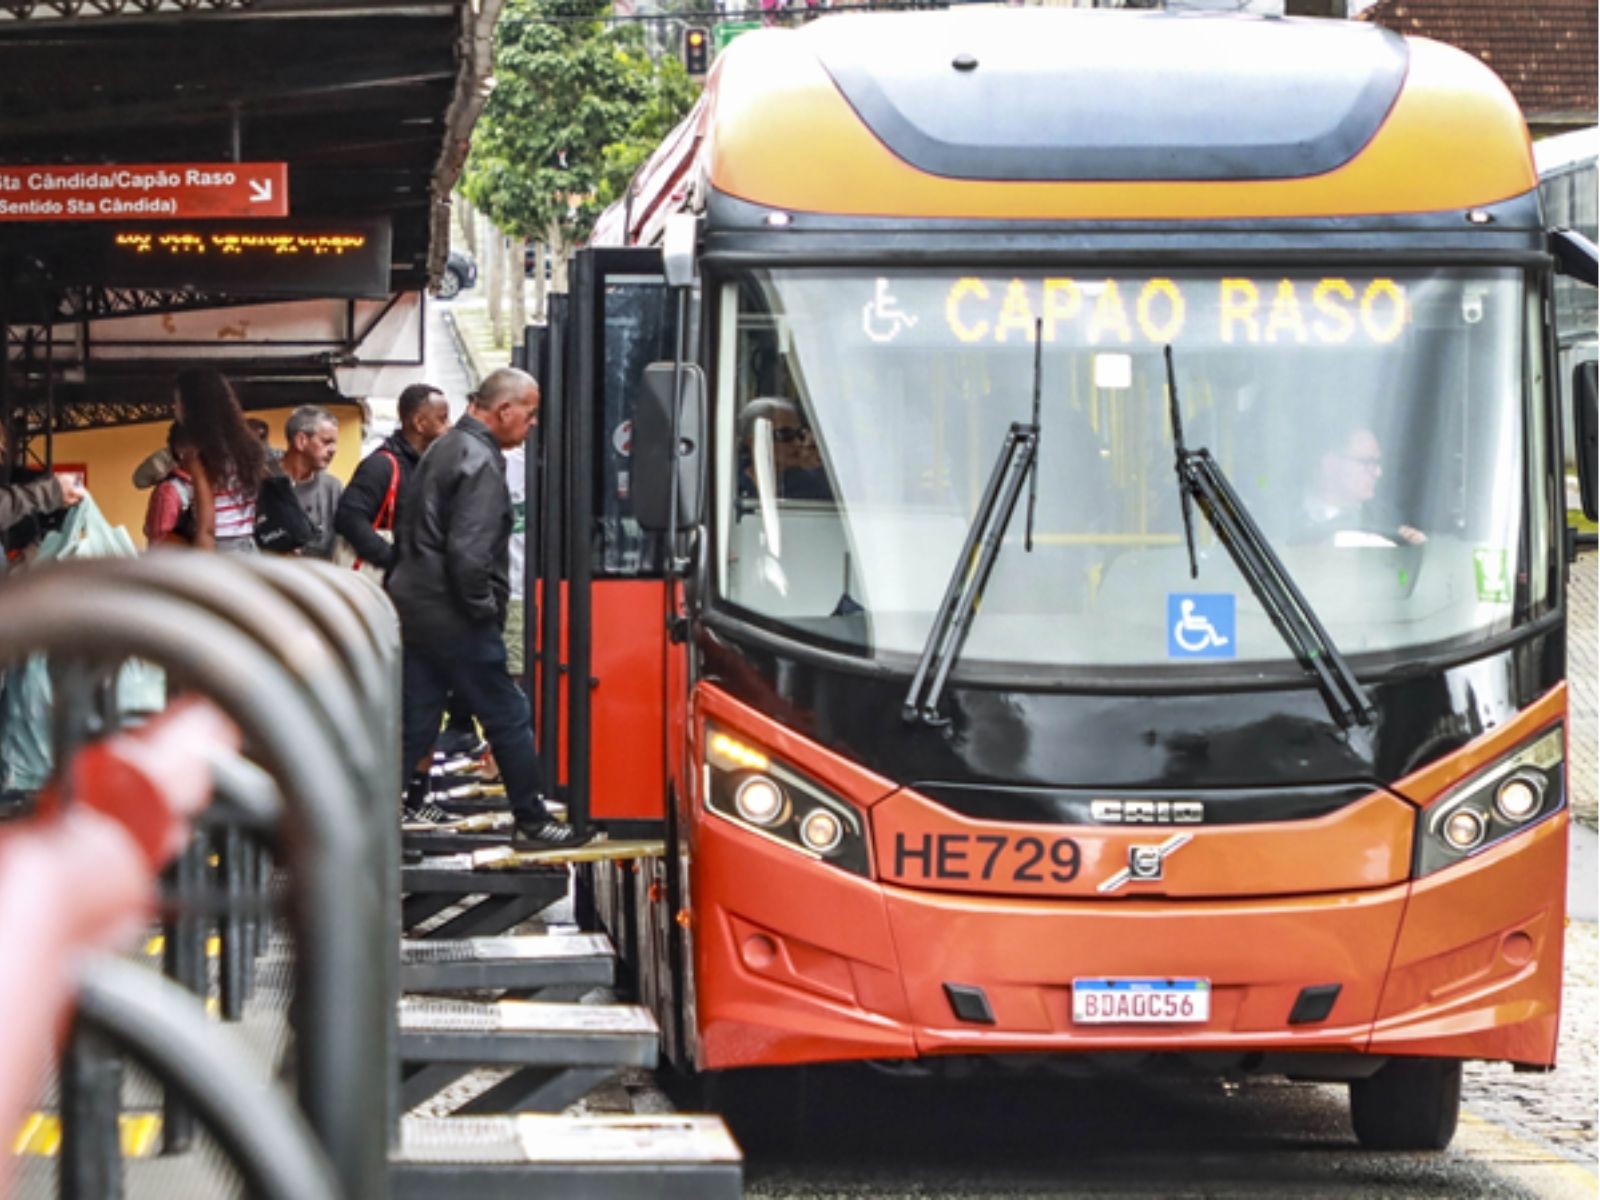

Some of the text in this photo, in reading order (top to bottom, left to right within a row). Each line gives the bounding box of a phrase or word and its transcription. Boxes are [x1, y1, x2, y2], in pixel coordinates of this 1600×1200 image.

[0, 169, 235, 191] ta Cândida/Capão Raso
[67, 198, 95, 214] Sta
[100, 197, 177, 215] Cândida)
[1220, 277, 1410, 343] RASO
[894, 832, 1081, 882] HE729
